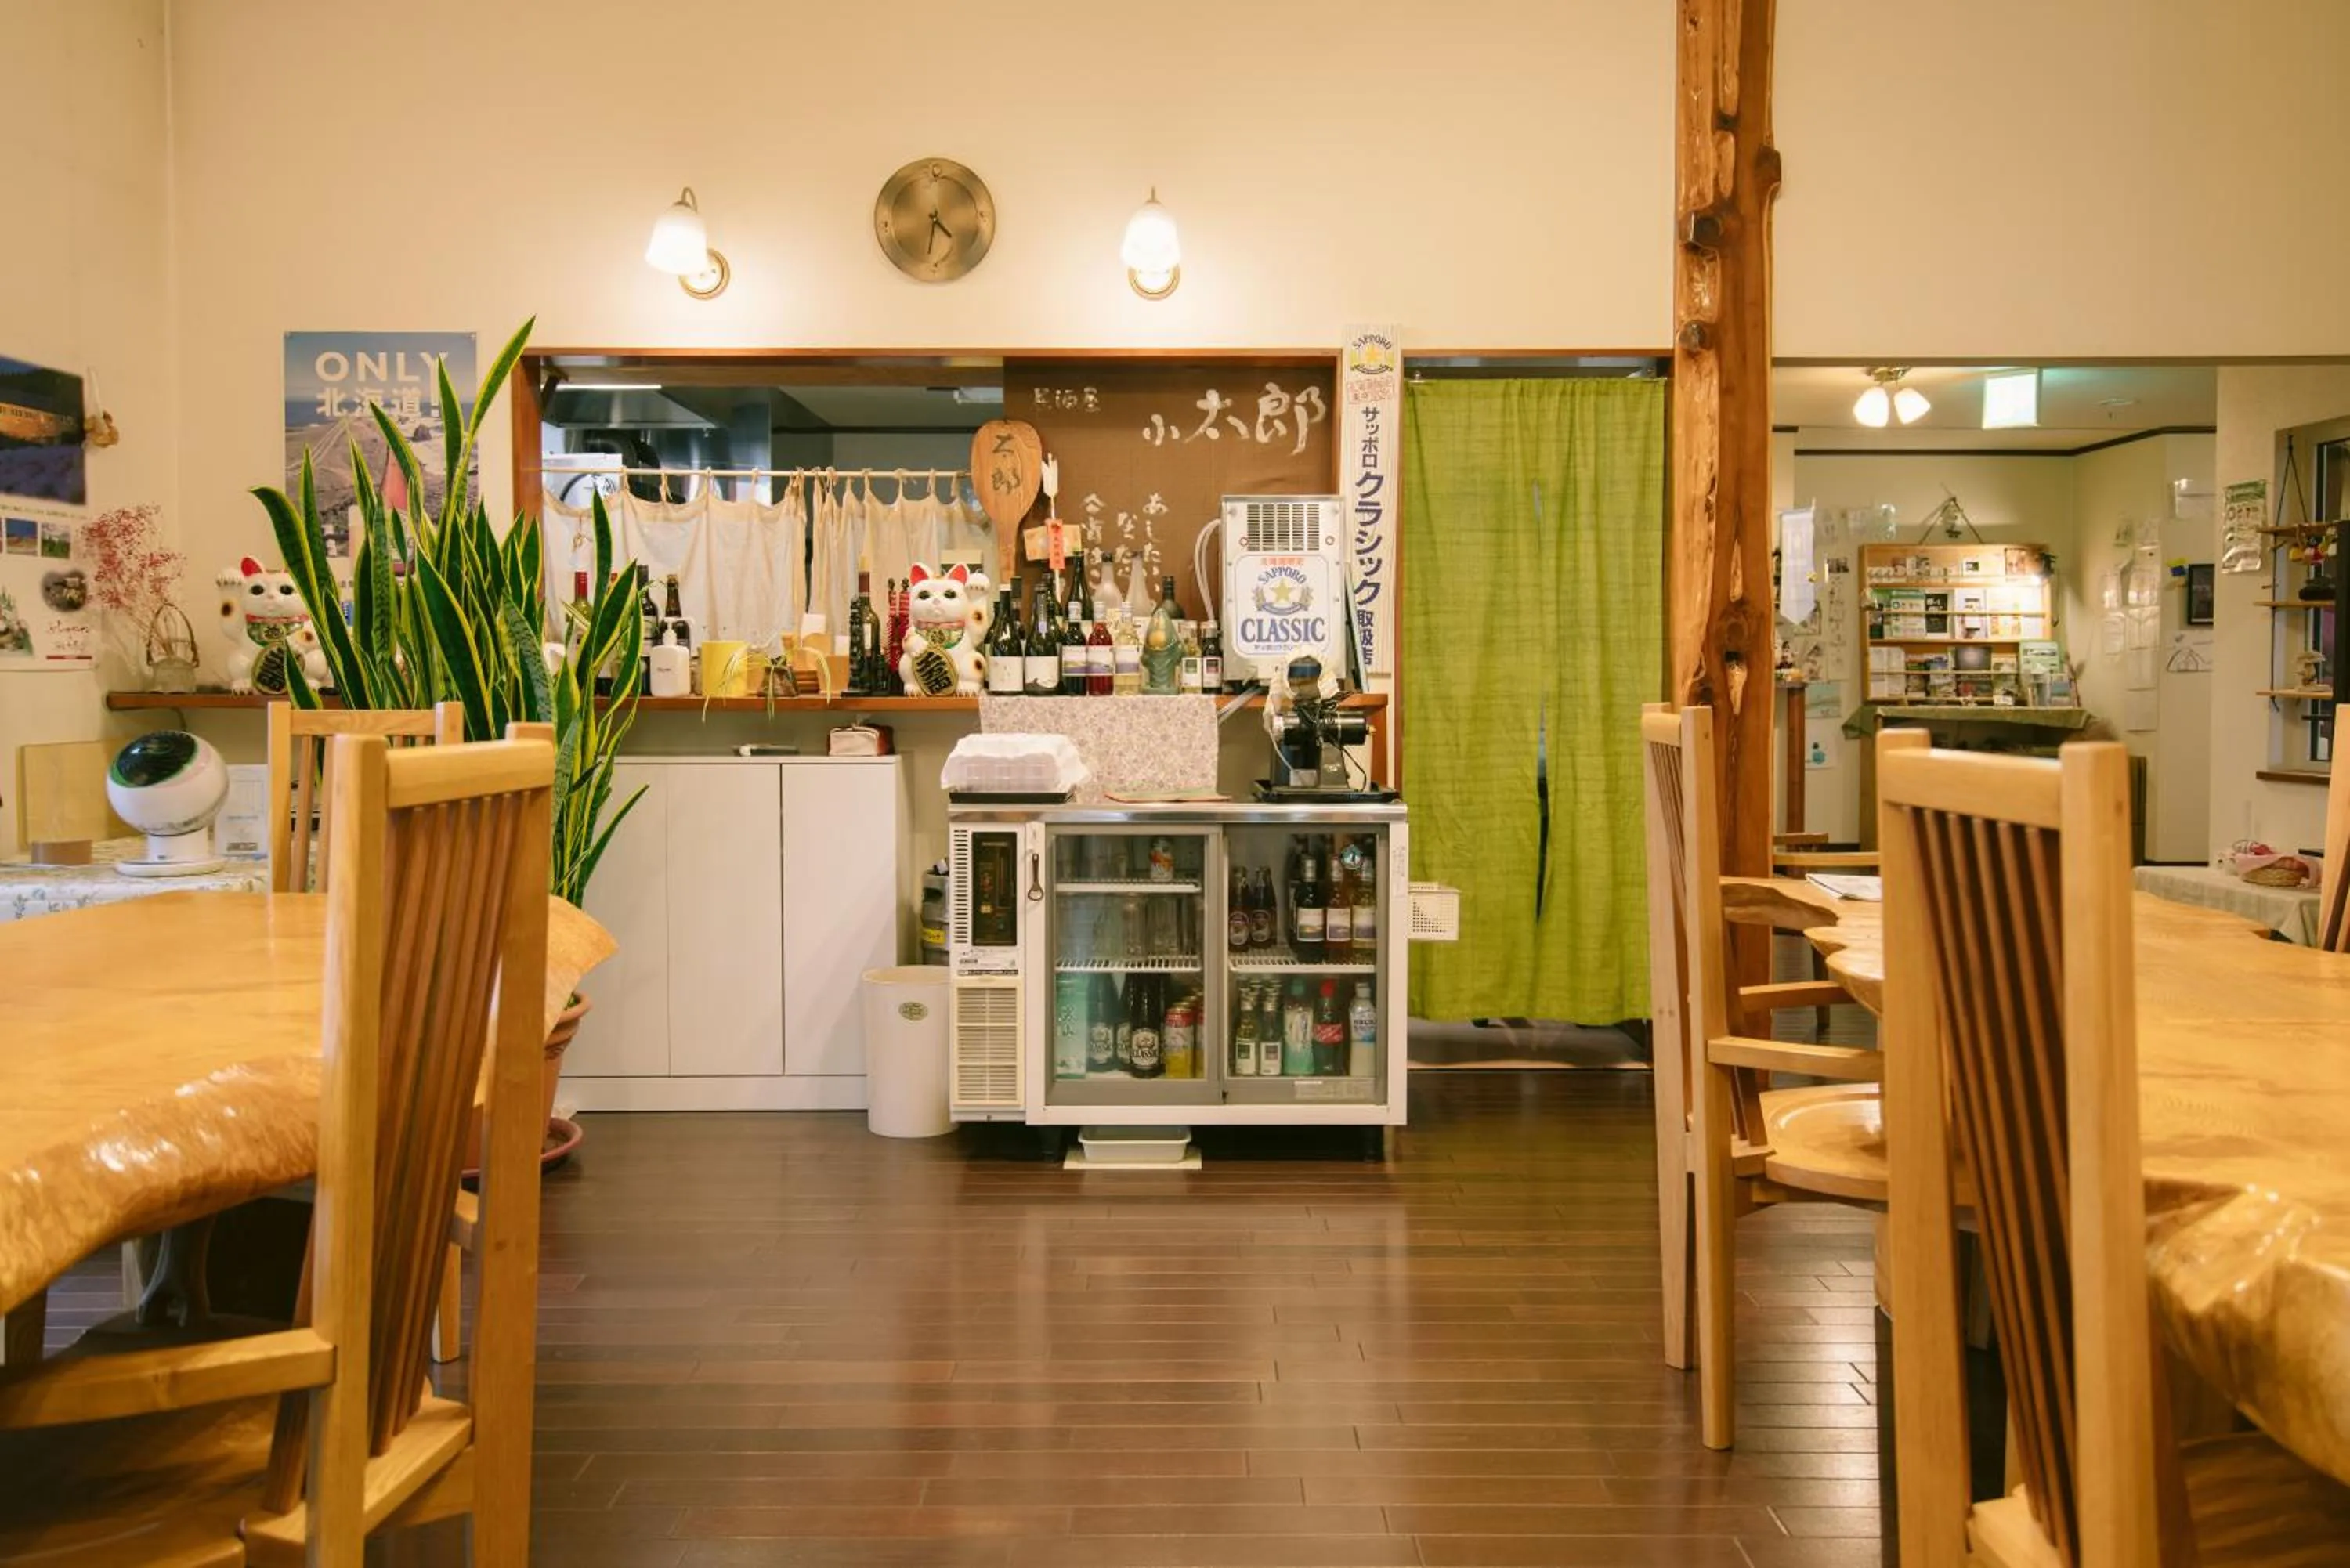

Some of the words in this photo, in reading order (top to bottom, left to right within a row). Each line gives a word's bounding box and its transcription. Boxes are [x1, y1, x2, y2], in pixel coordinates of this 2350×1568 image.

[315, 351, 449, 382] ONLY
[1141, 381, 1328, 457] 小太郎
[1257, 565, 1307, 585] SAPPORO
[1240, 617, 1326, 644] CLASSIC
